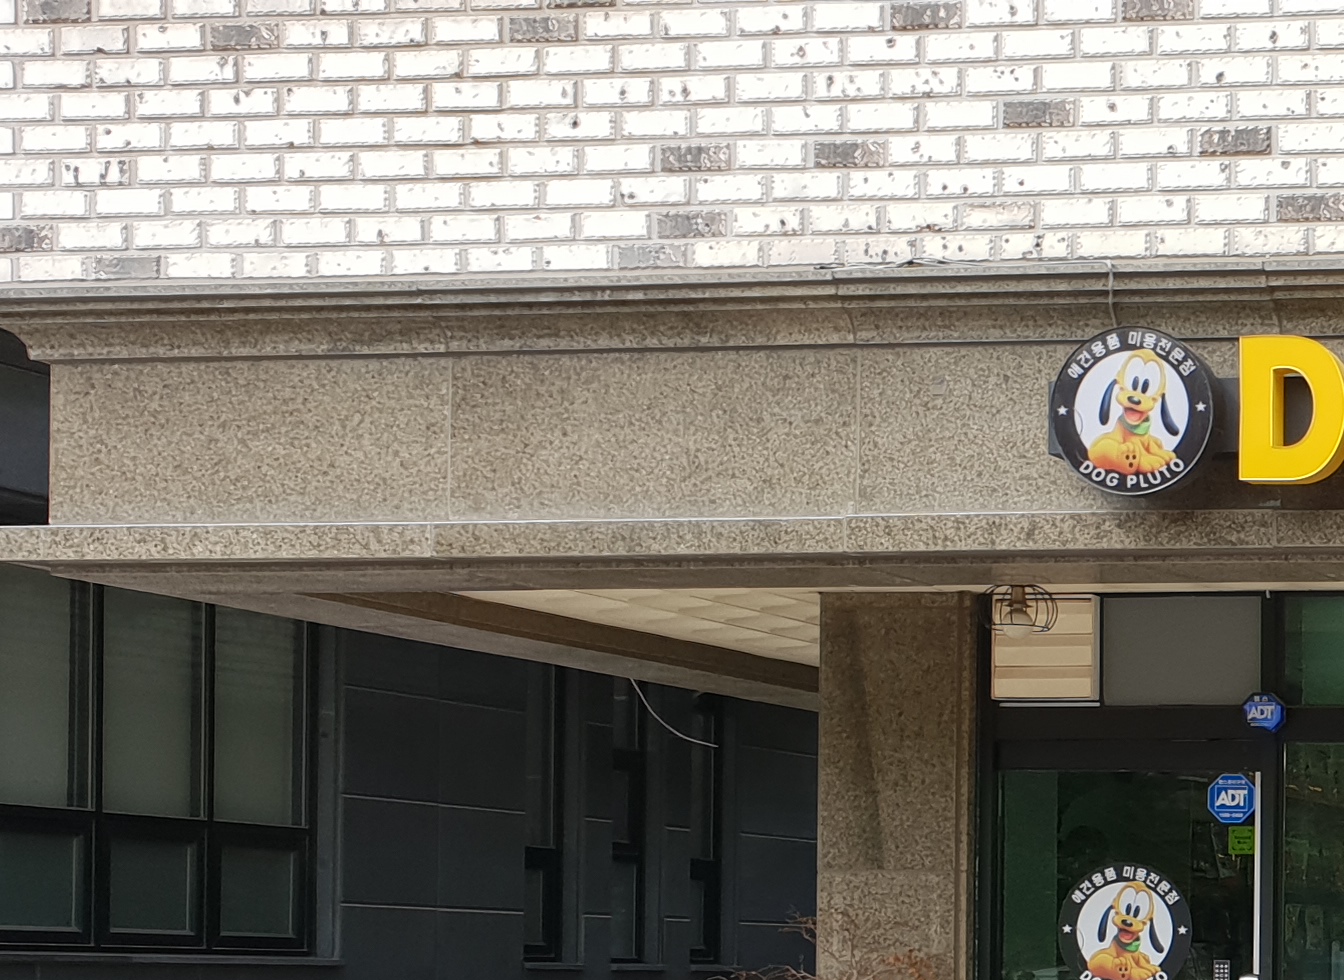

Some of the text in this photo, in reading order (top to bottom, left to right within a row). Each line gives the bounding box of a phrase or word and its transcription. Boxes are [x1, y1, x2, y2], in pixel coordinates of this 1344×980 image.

[1127, 331, 1196, 377] 미용전문점
[1079, 458, 1185, 489] DOG PLUTO
[1247, 705, 1275, 719] ADT
[1215, 789, 1248, 807] ADT
[1122, 865, 1180, 906] 미용전문점
